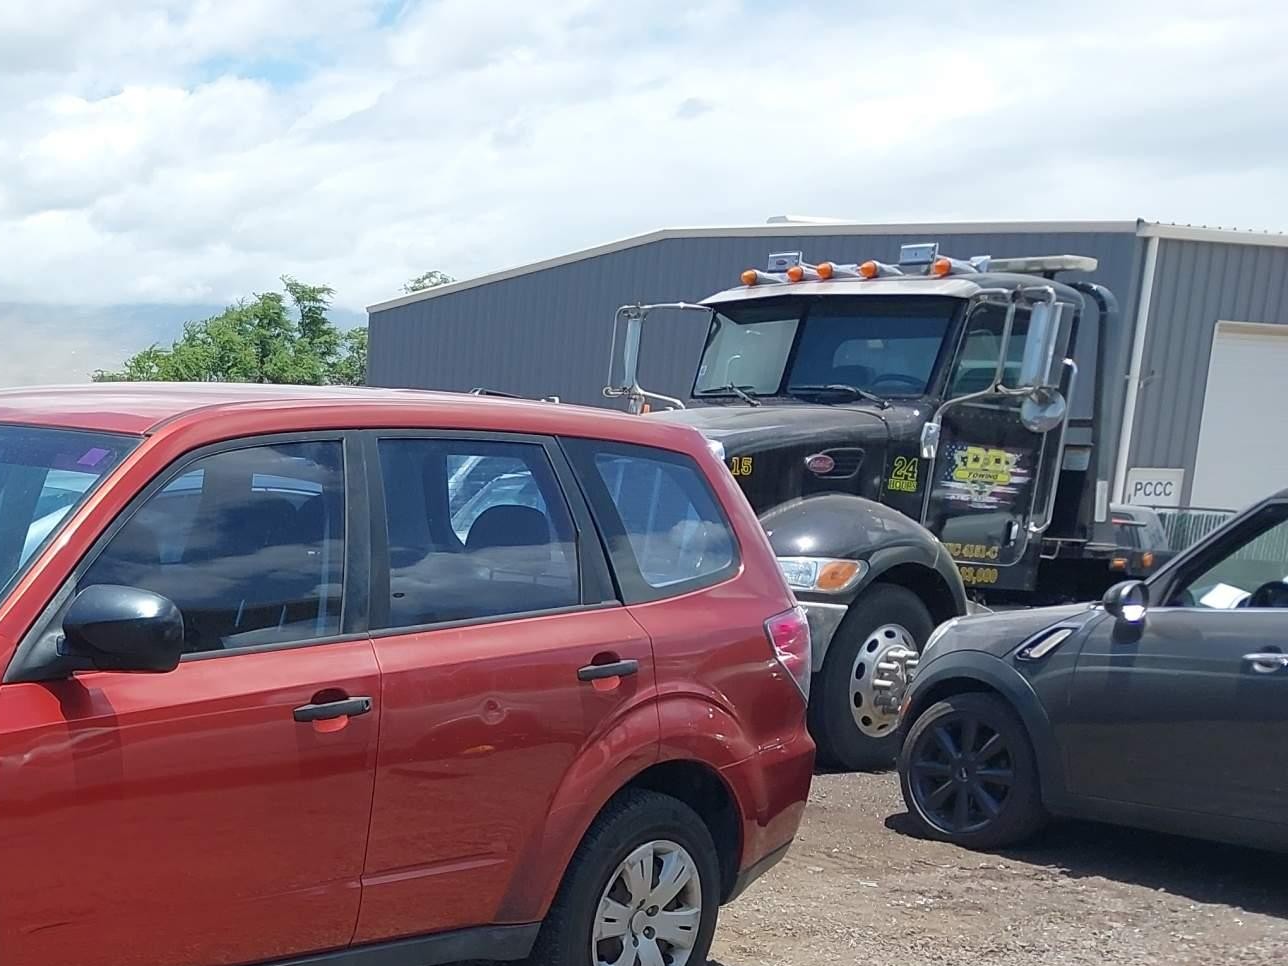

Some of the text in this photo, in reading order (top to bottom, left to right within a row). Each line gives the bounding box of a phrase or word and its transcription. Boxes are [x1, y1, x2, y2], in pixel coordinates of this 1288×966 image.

[731, 456, 753, 475] 15
[892, 456, 918, 480] 24
[967, 472, 999, 481] TOWING
[888, 478, 918, 492] HOURS
[1134, 481, 1173, 497] PCCC
